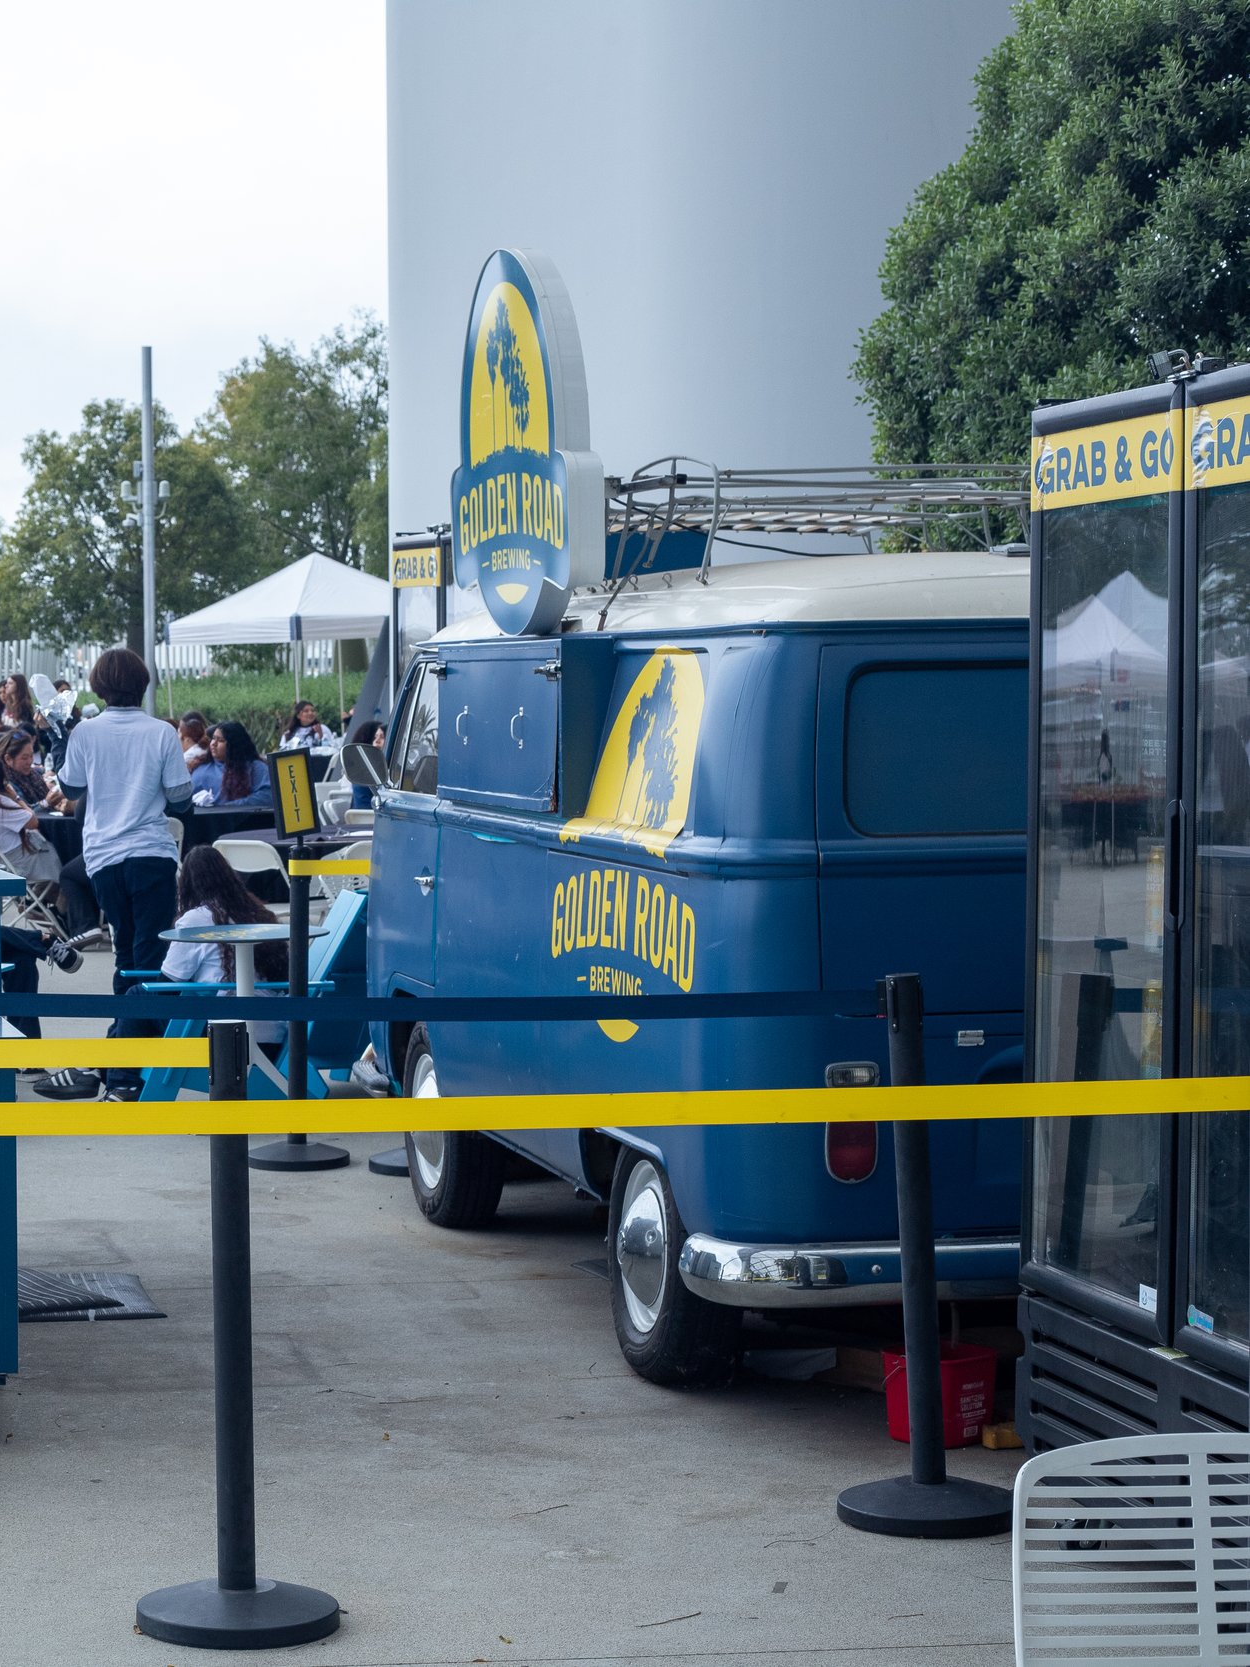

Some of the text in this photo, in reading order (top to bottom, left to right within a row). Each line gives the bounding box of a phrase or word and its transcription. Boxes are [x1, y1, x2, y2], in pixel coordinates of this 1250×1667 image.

[1035, 427, 1174, 495] GRAB & GO
[459, 472, 564, 556] GOLDEN ROAD
[394, 557, 418, 580] GRAB
[491, 548, 530, 572] BREWING
[288, 765, 300, 822] EXIT
[551, 869, 696, 993] GOLDEN ROAD
[590, 966, 642, 996] BREWING
